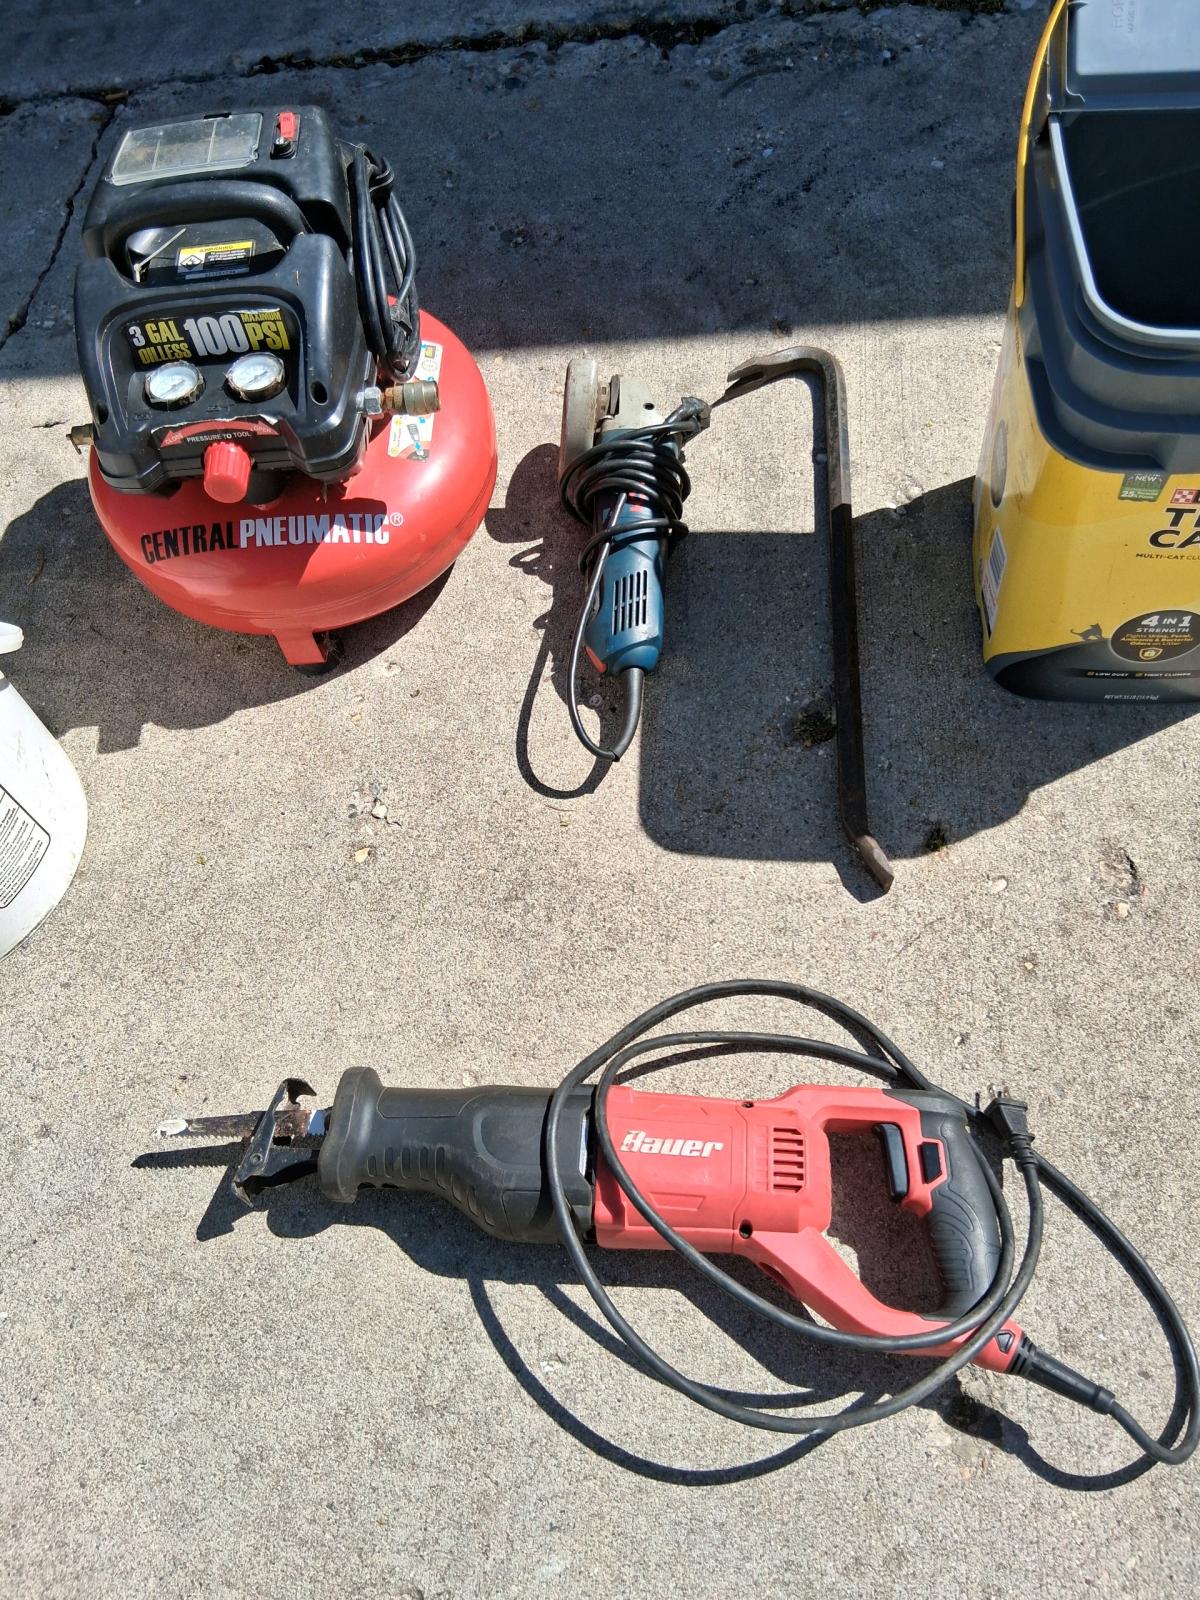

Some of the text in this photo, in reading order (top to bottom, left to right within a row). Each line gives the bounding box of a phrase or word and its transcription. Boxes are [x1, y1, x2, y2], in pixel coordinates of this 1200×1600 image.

[240, 311, 282, 323] MAXIMUM
[128, 314, 290, 356] 3 GAL 100 PSI
[139, 343, 192, 364] OILLESS
[186, 434, 222, 443] PRESSURE
[140, 521, 240, 565] CENTRAL
[1141, 615, 1160, 627] 4
[1178, 615, 1192, 627] 1
[620, 1130, 724, 1157] Bauer
